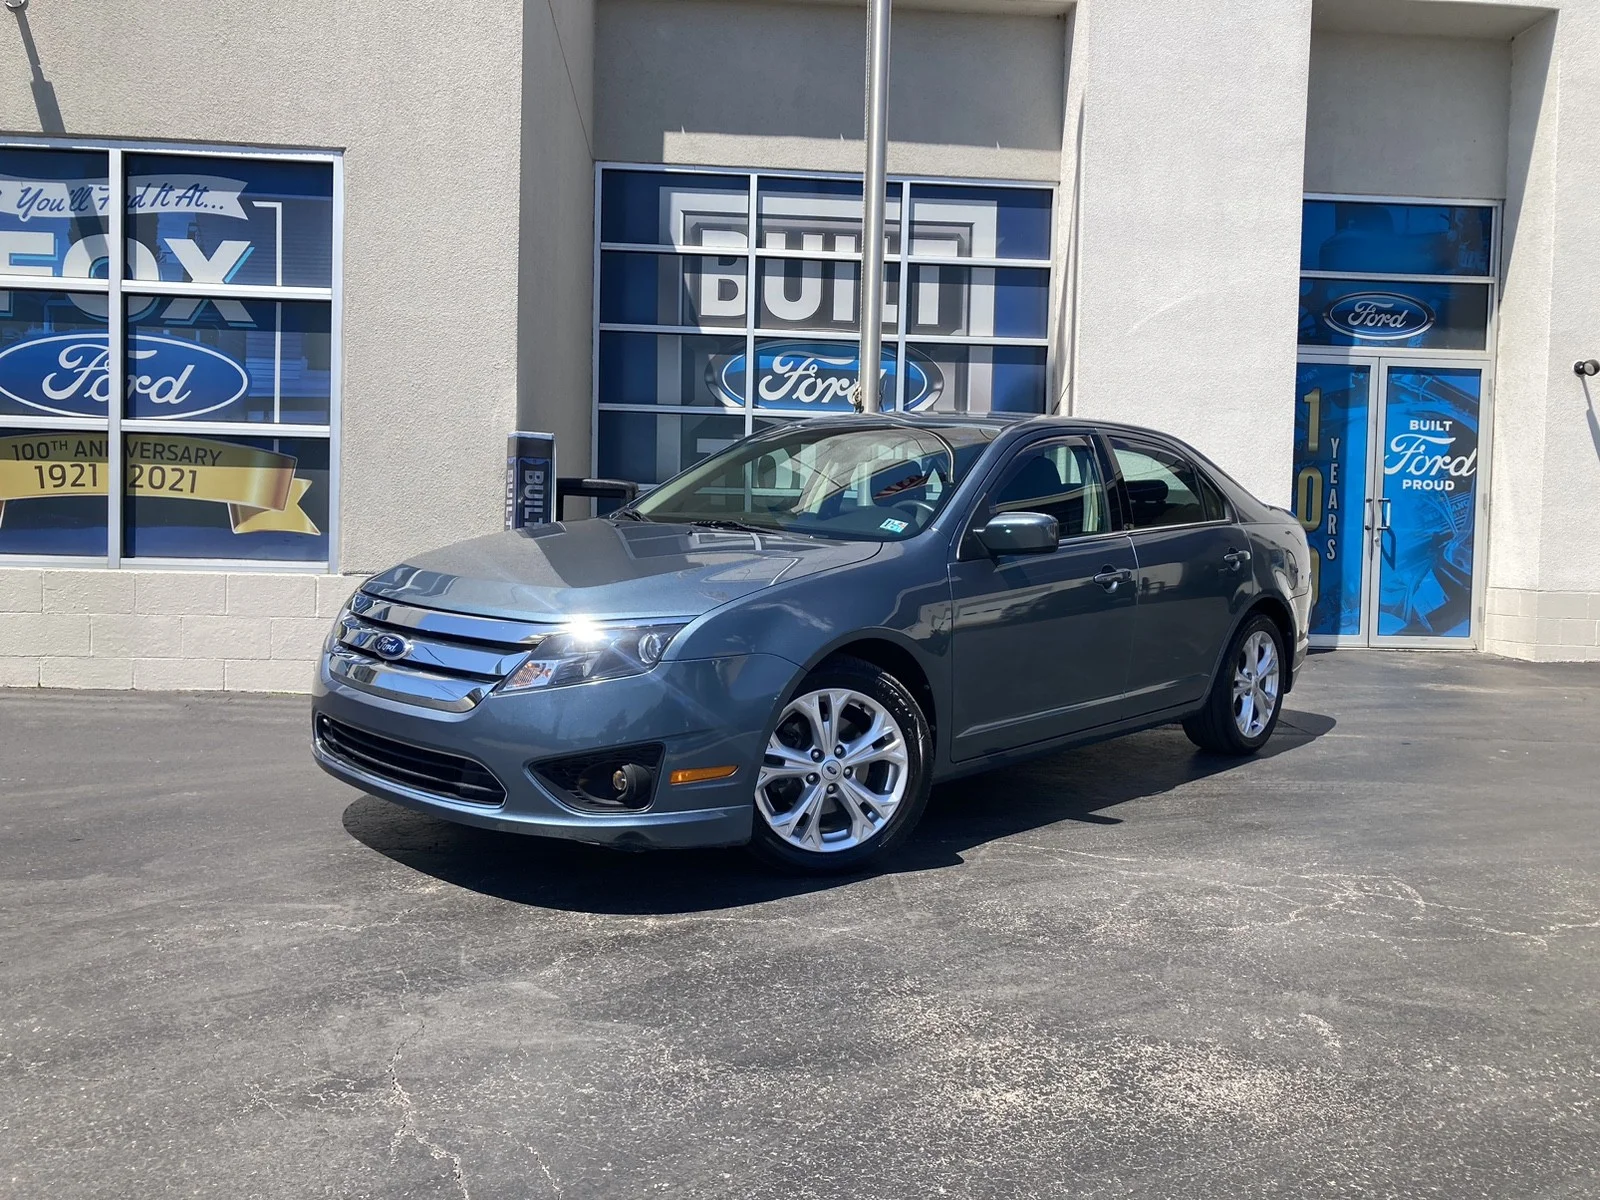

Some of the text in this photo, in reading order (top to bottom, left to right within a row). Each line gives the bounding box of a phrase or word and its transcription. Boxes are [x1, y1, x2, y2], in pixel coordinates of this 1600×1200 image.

[16, 186, 93, 219] You'll
[150, 182, 175, 207] It
[175, 182, 224, 210] At...
[1347, 300, 1409, 328] Ford
[1409, 419, 1453, 432] BUILT
[12, 440, 223, 467] 100TH ANVERSARY
[1383, 433, 1478, 478] Ford
[34, 463, 197, 494] 1921 2021
[1402, 479, 1456, 491] PROUD
[524, 469, 545, 529] BUILT
[1327, 437, 1340, 561] YEARS
[376, 636, 399, 653] Ford
